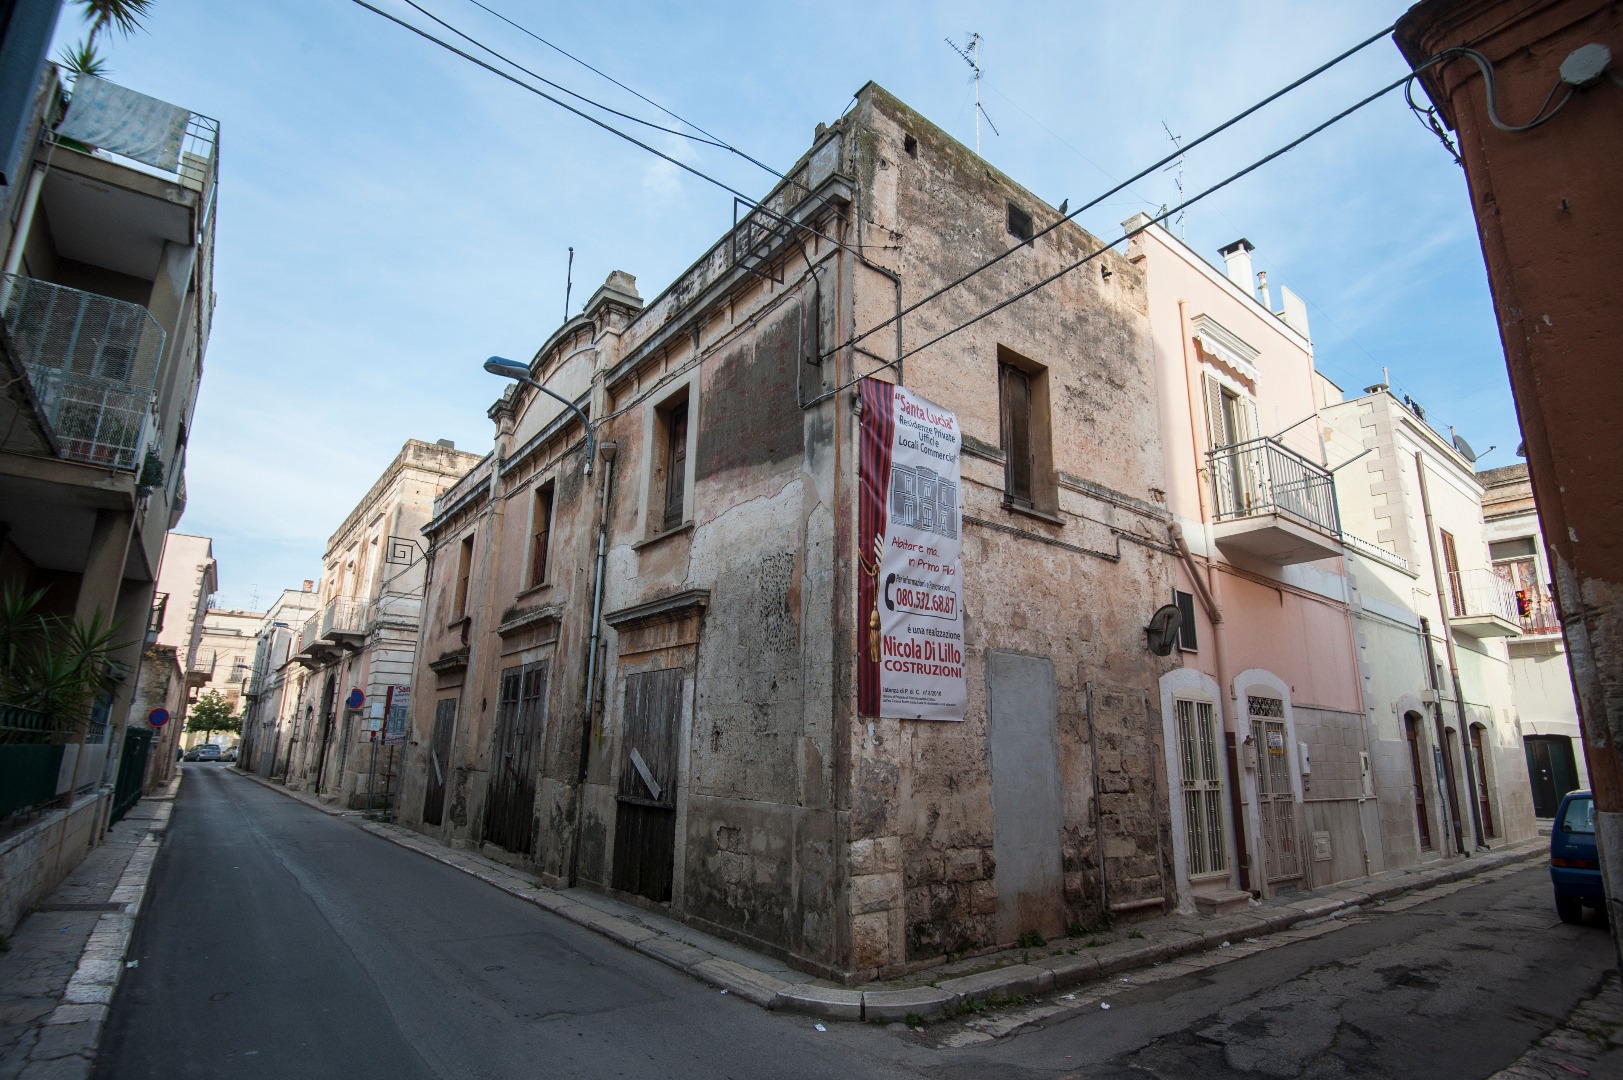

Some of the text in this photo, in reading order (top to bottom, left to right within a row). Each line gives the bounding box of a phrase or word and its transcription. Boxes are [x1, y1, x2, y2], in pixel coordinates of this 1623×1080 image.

[900, 414, 956, 443] Residenze Private
[898, 435, 918, 450] Locali
[892, 536, 924, 552] Abitare
[908, 556, 915, 567] in
[917, 558, 939, 572] Prima
[896, 588, 954, 614] 080.532.68.87
[912, 626, 924, 634] una
[926, 628, 960, 640] realizzazione
[884, 635, 960, 664] Nicola Di Lillo
[884, 660, 962, 678] COSTRUZIONI
